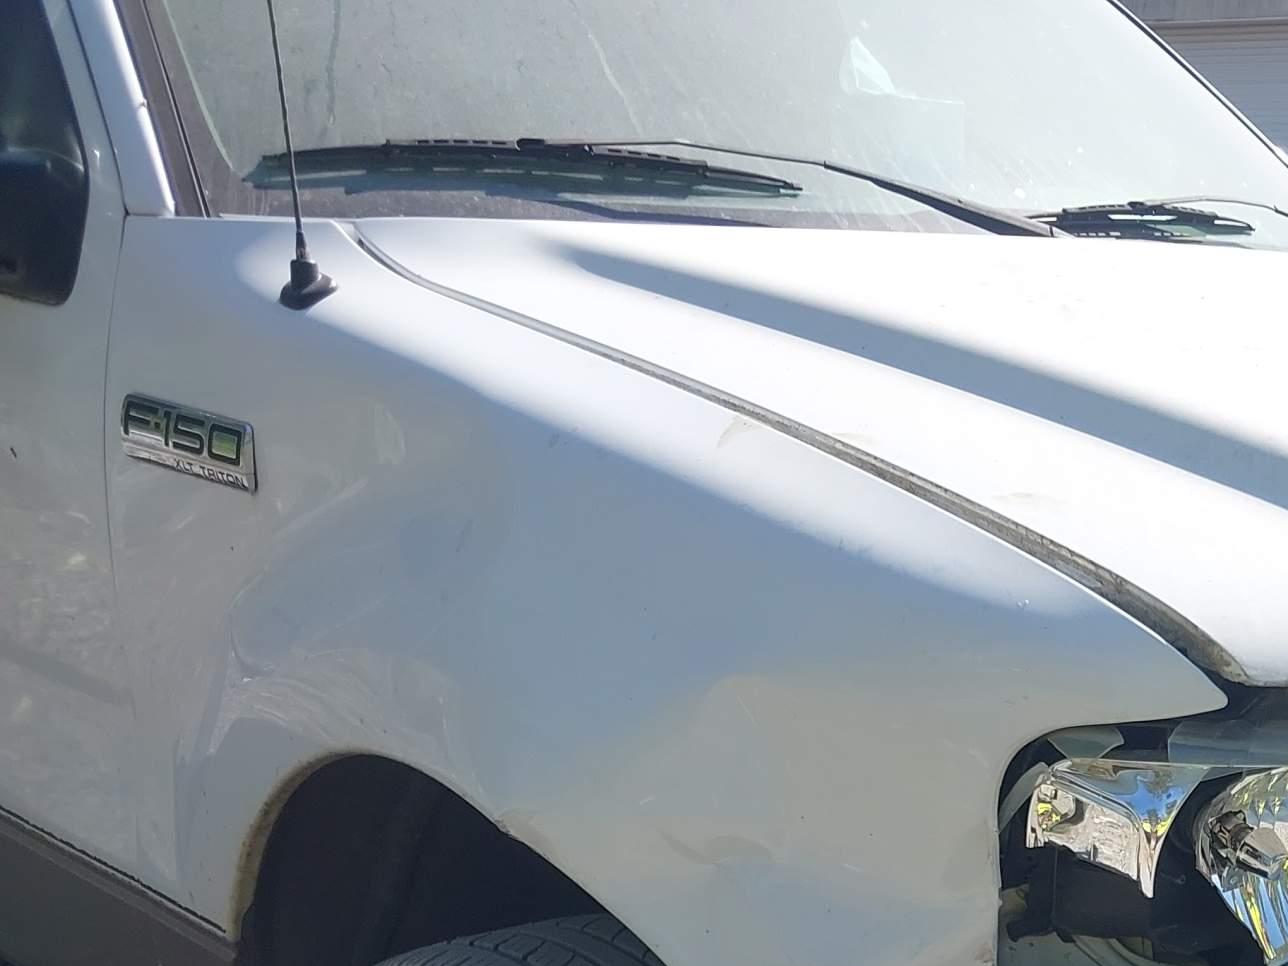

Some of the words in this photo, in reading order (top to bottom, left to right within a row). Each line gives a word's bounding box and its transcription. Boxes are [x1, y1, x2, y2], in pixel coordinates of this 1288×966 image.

[124, 400, 243, 466] F-150
[173, 457, 195, 473] XLT
[199, 466, 247, 489] TRITON
